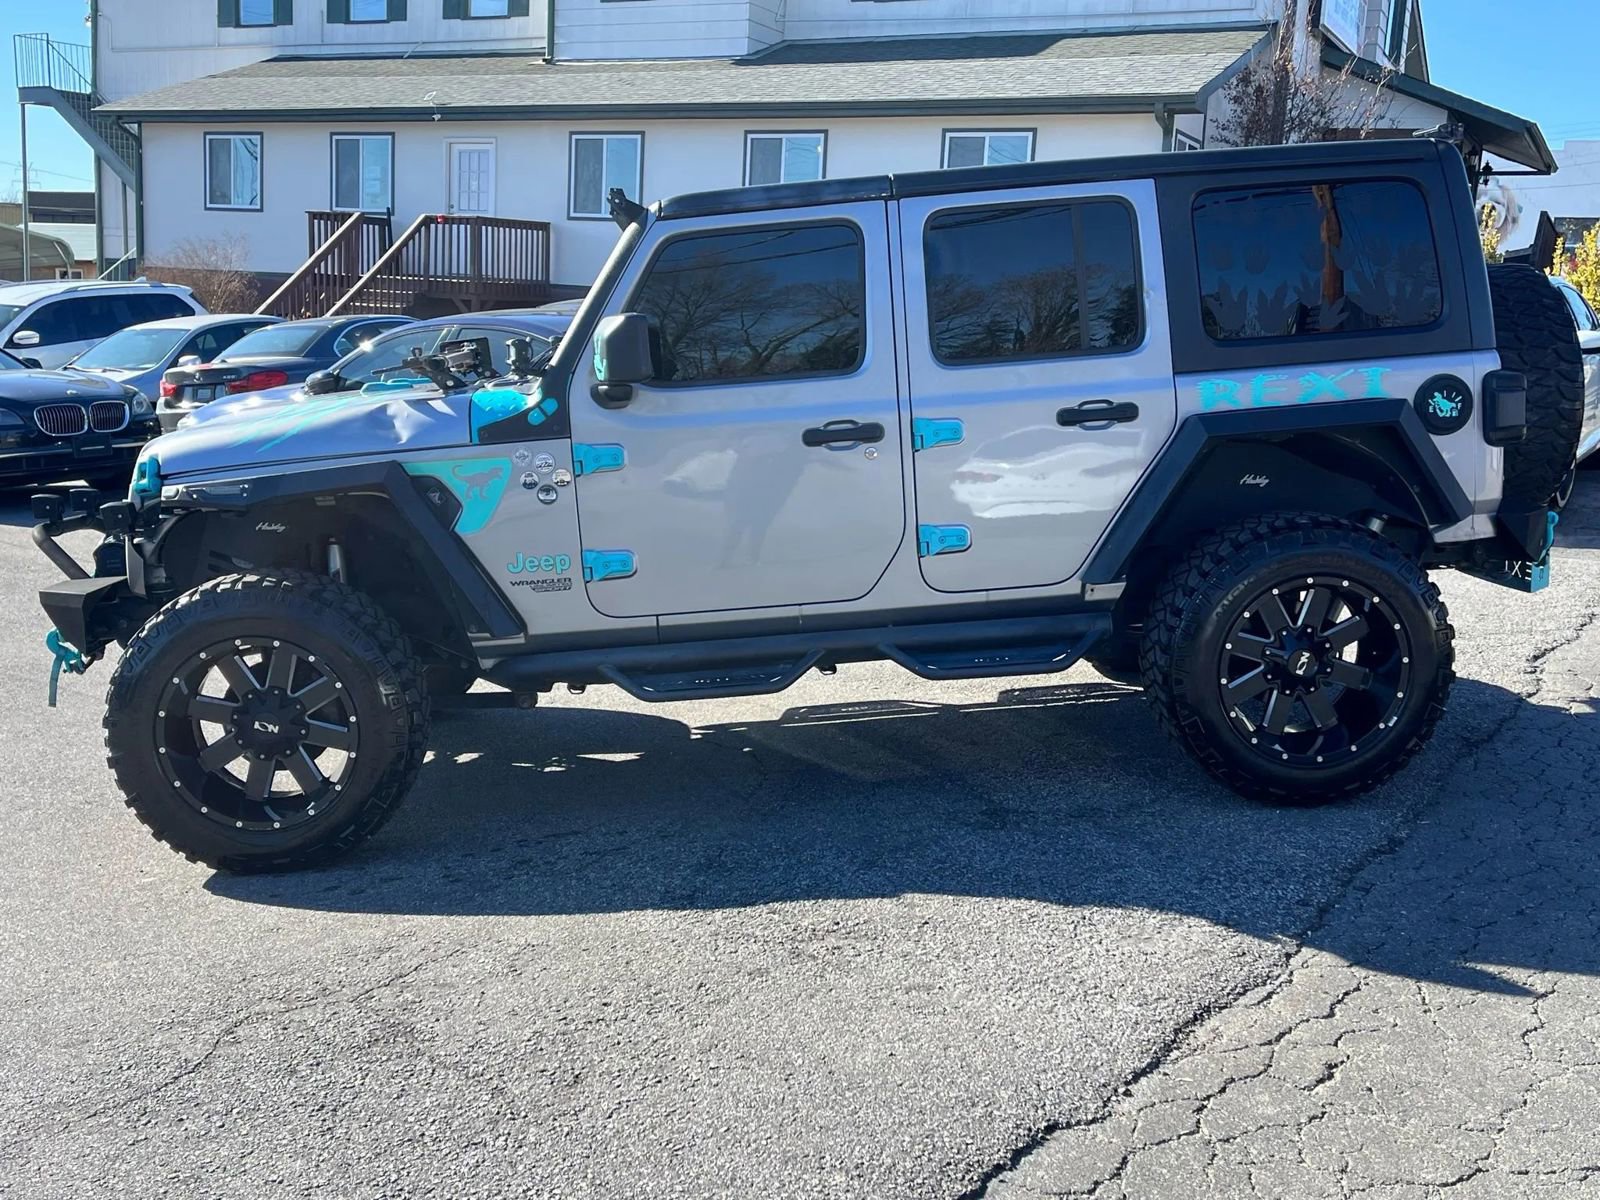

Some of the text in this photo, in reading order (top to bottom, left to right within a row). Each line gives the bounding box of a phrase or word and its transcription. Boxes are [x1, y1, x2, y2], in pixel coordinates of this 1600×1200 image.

[1196, 366, 1391, 411] REXI
[507, 552, 571, 575] Jeep
[509, 577, 572, 587] WRANGLER
[1295, 651, 1311, 676] ION
[254, 720, 279, 734] ION
